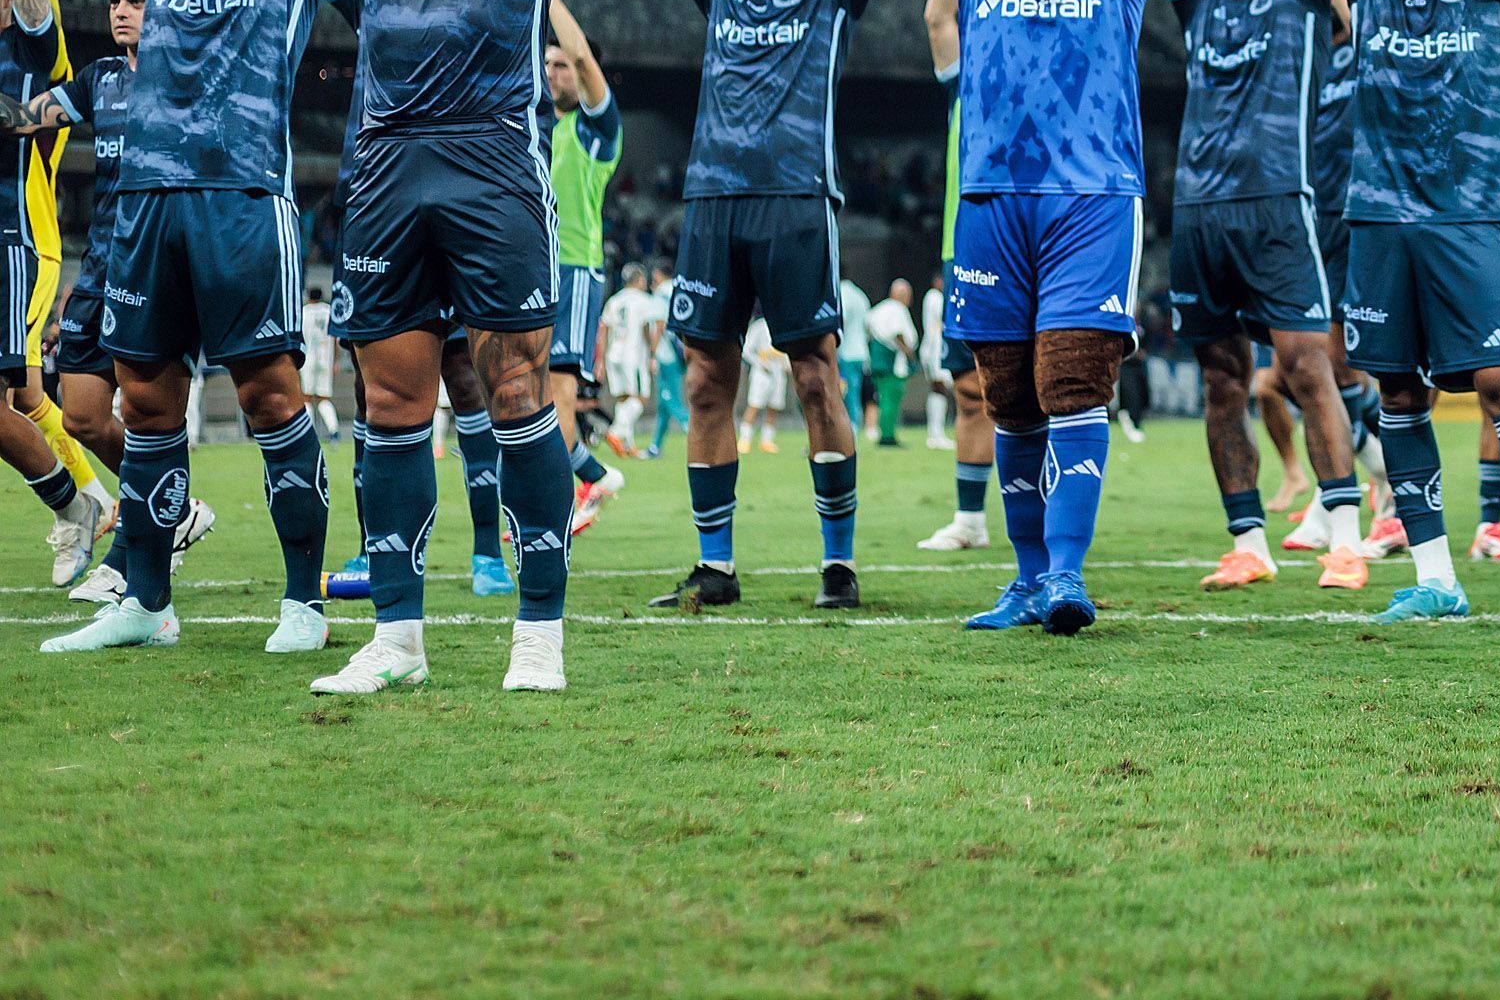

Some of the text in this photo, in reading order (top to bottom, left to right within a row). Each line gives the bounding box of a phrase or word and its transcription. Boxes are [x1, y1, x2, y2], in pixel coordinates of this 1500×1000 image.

[728, 18, 810, 46] betfair
[1388, 26, 1480, 60] betfair
[343, 253, 391, 274] betfair
[958, 266, 999, 287] betfair
[158, 472, 187, 521] Kodilar
